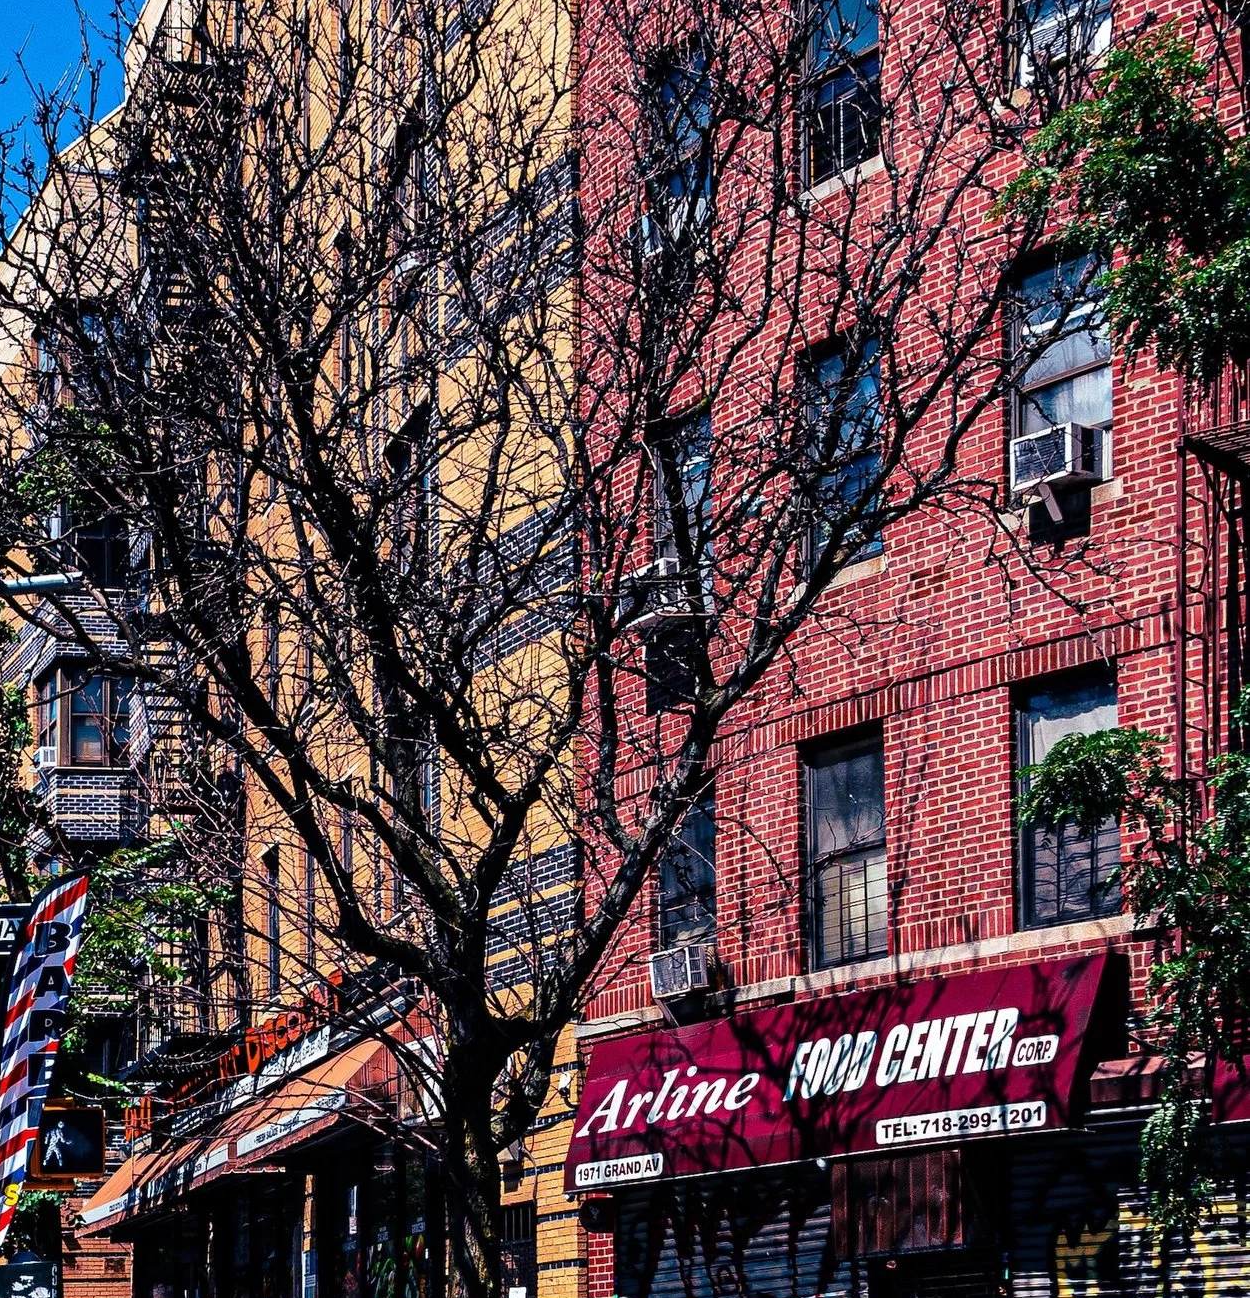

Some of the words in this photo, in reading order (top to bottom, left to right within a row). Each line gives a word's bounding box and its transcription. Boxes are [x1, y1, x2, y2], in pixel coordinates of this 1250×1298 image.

[575, 1066, 760, 1139] Arline
[782, 1031, 878, 1102] FOOD
[875, 1007, 1020, 1087] CENTER
[1016, 1040, 1052, 1062] CORP.
[882, 1122, 917, 1140] TEL:
[920, 1106, 1043, 1136] 718-299-1201
[578, 1167, 601, 1182] 1971
[604, 1162, 641, 1179] GRAND
[644, 1158, 660, 1173] AV
